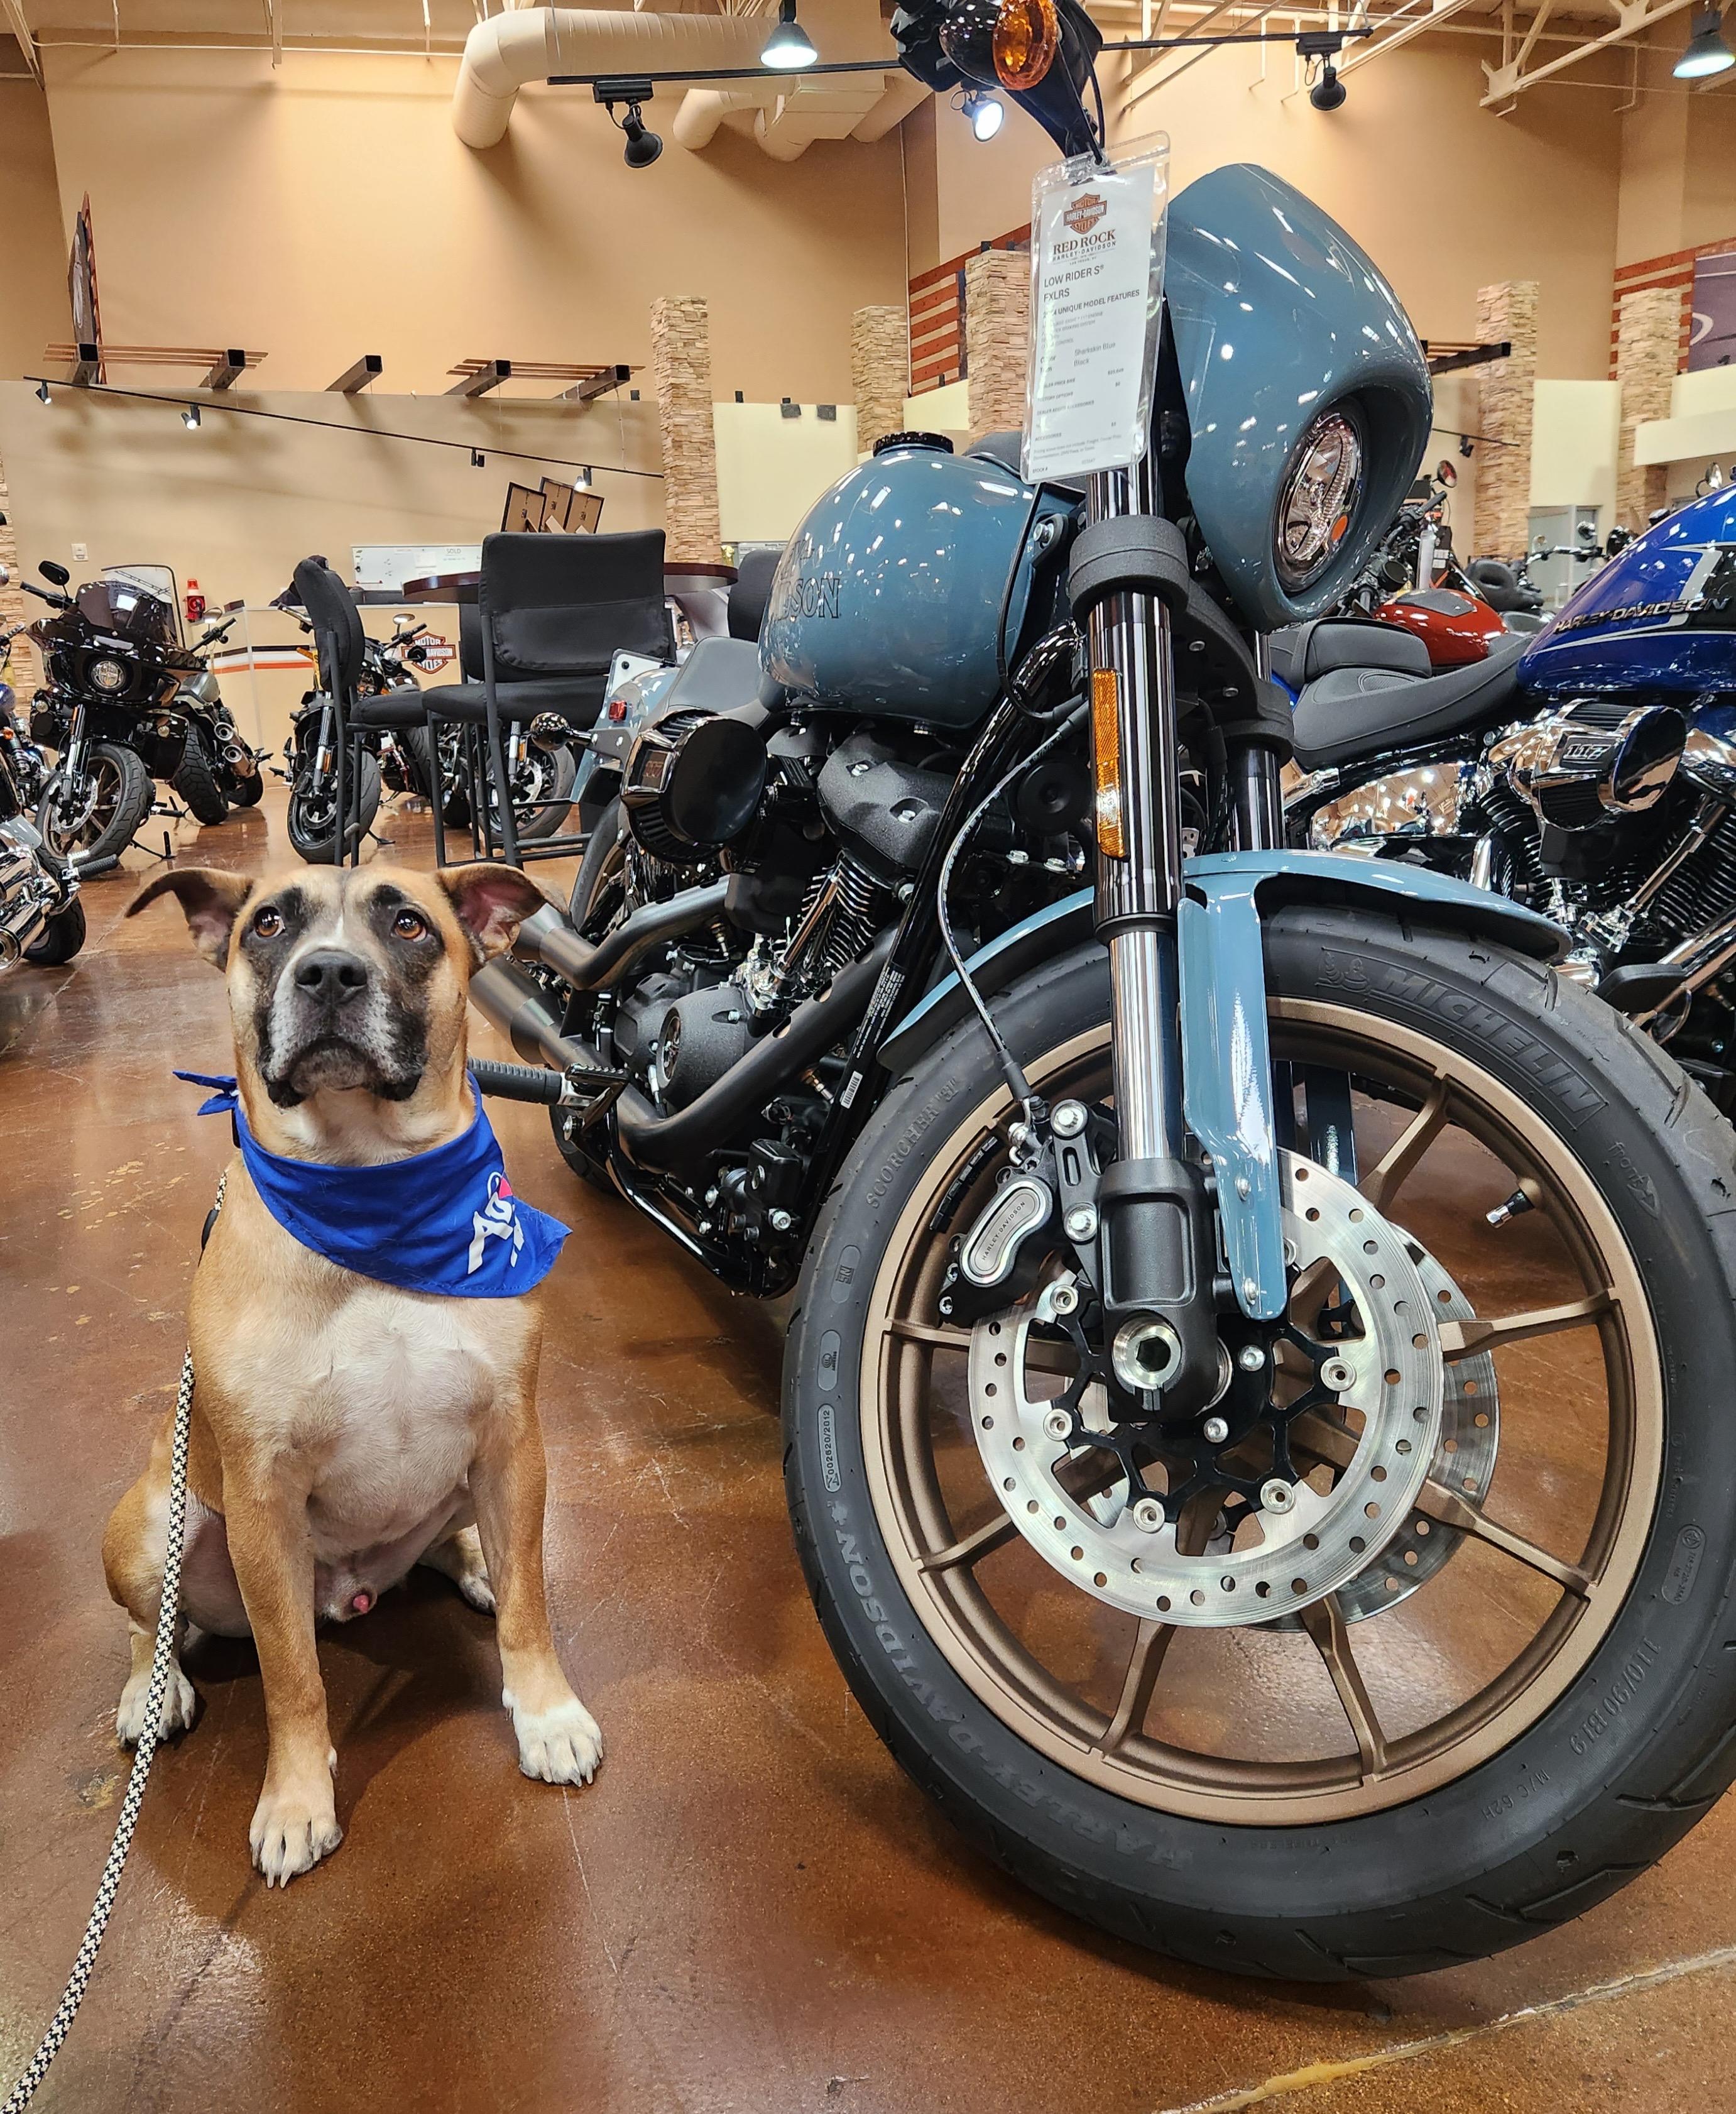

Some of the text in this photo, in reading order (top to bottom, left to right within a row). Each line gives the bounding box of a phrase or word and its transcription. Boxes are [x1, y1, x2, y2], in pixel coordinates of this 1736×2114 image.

[1054, 229, 1116, 255] RED ROCK
[1044, 273, 1064, 288] LOW
[1066, 267, 1093, 282] RIDER
[1044, 288, 1070, 302] FXLRS
[1058, 302, 1083, 314] UNIQUE
[1083, 298, 1106, 309] MODEL
[1107, 289, 1140, 303] FEATURES
[1074, 358, 1089, 367] Black
[1103, 342, 1116, 350] Blue
[1553, 596, 1731, 634] HARLEY-DAVIDSON
[415, 637, 441, 646] MOTOR
[1563, 743, 1612, 760] 117
[1382, 966, 1607, 1114] MICHELIN
[866, 1104, 941, 1210] SCORCHER
[1608, 1141, 1647, 1188] front
[981, 1201, 1026, 1261] HARLEY-DAVIDSON
[822, 1410, 834, 1475] 002620/2012
[1602, 1635, 1661, 1719] 110/90
[834, 1528, 1194, 1871] HARLEY-DAVIDSON
[1483, 1768, 1552, 1821] M/C 62H
